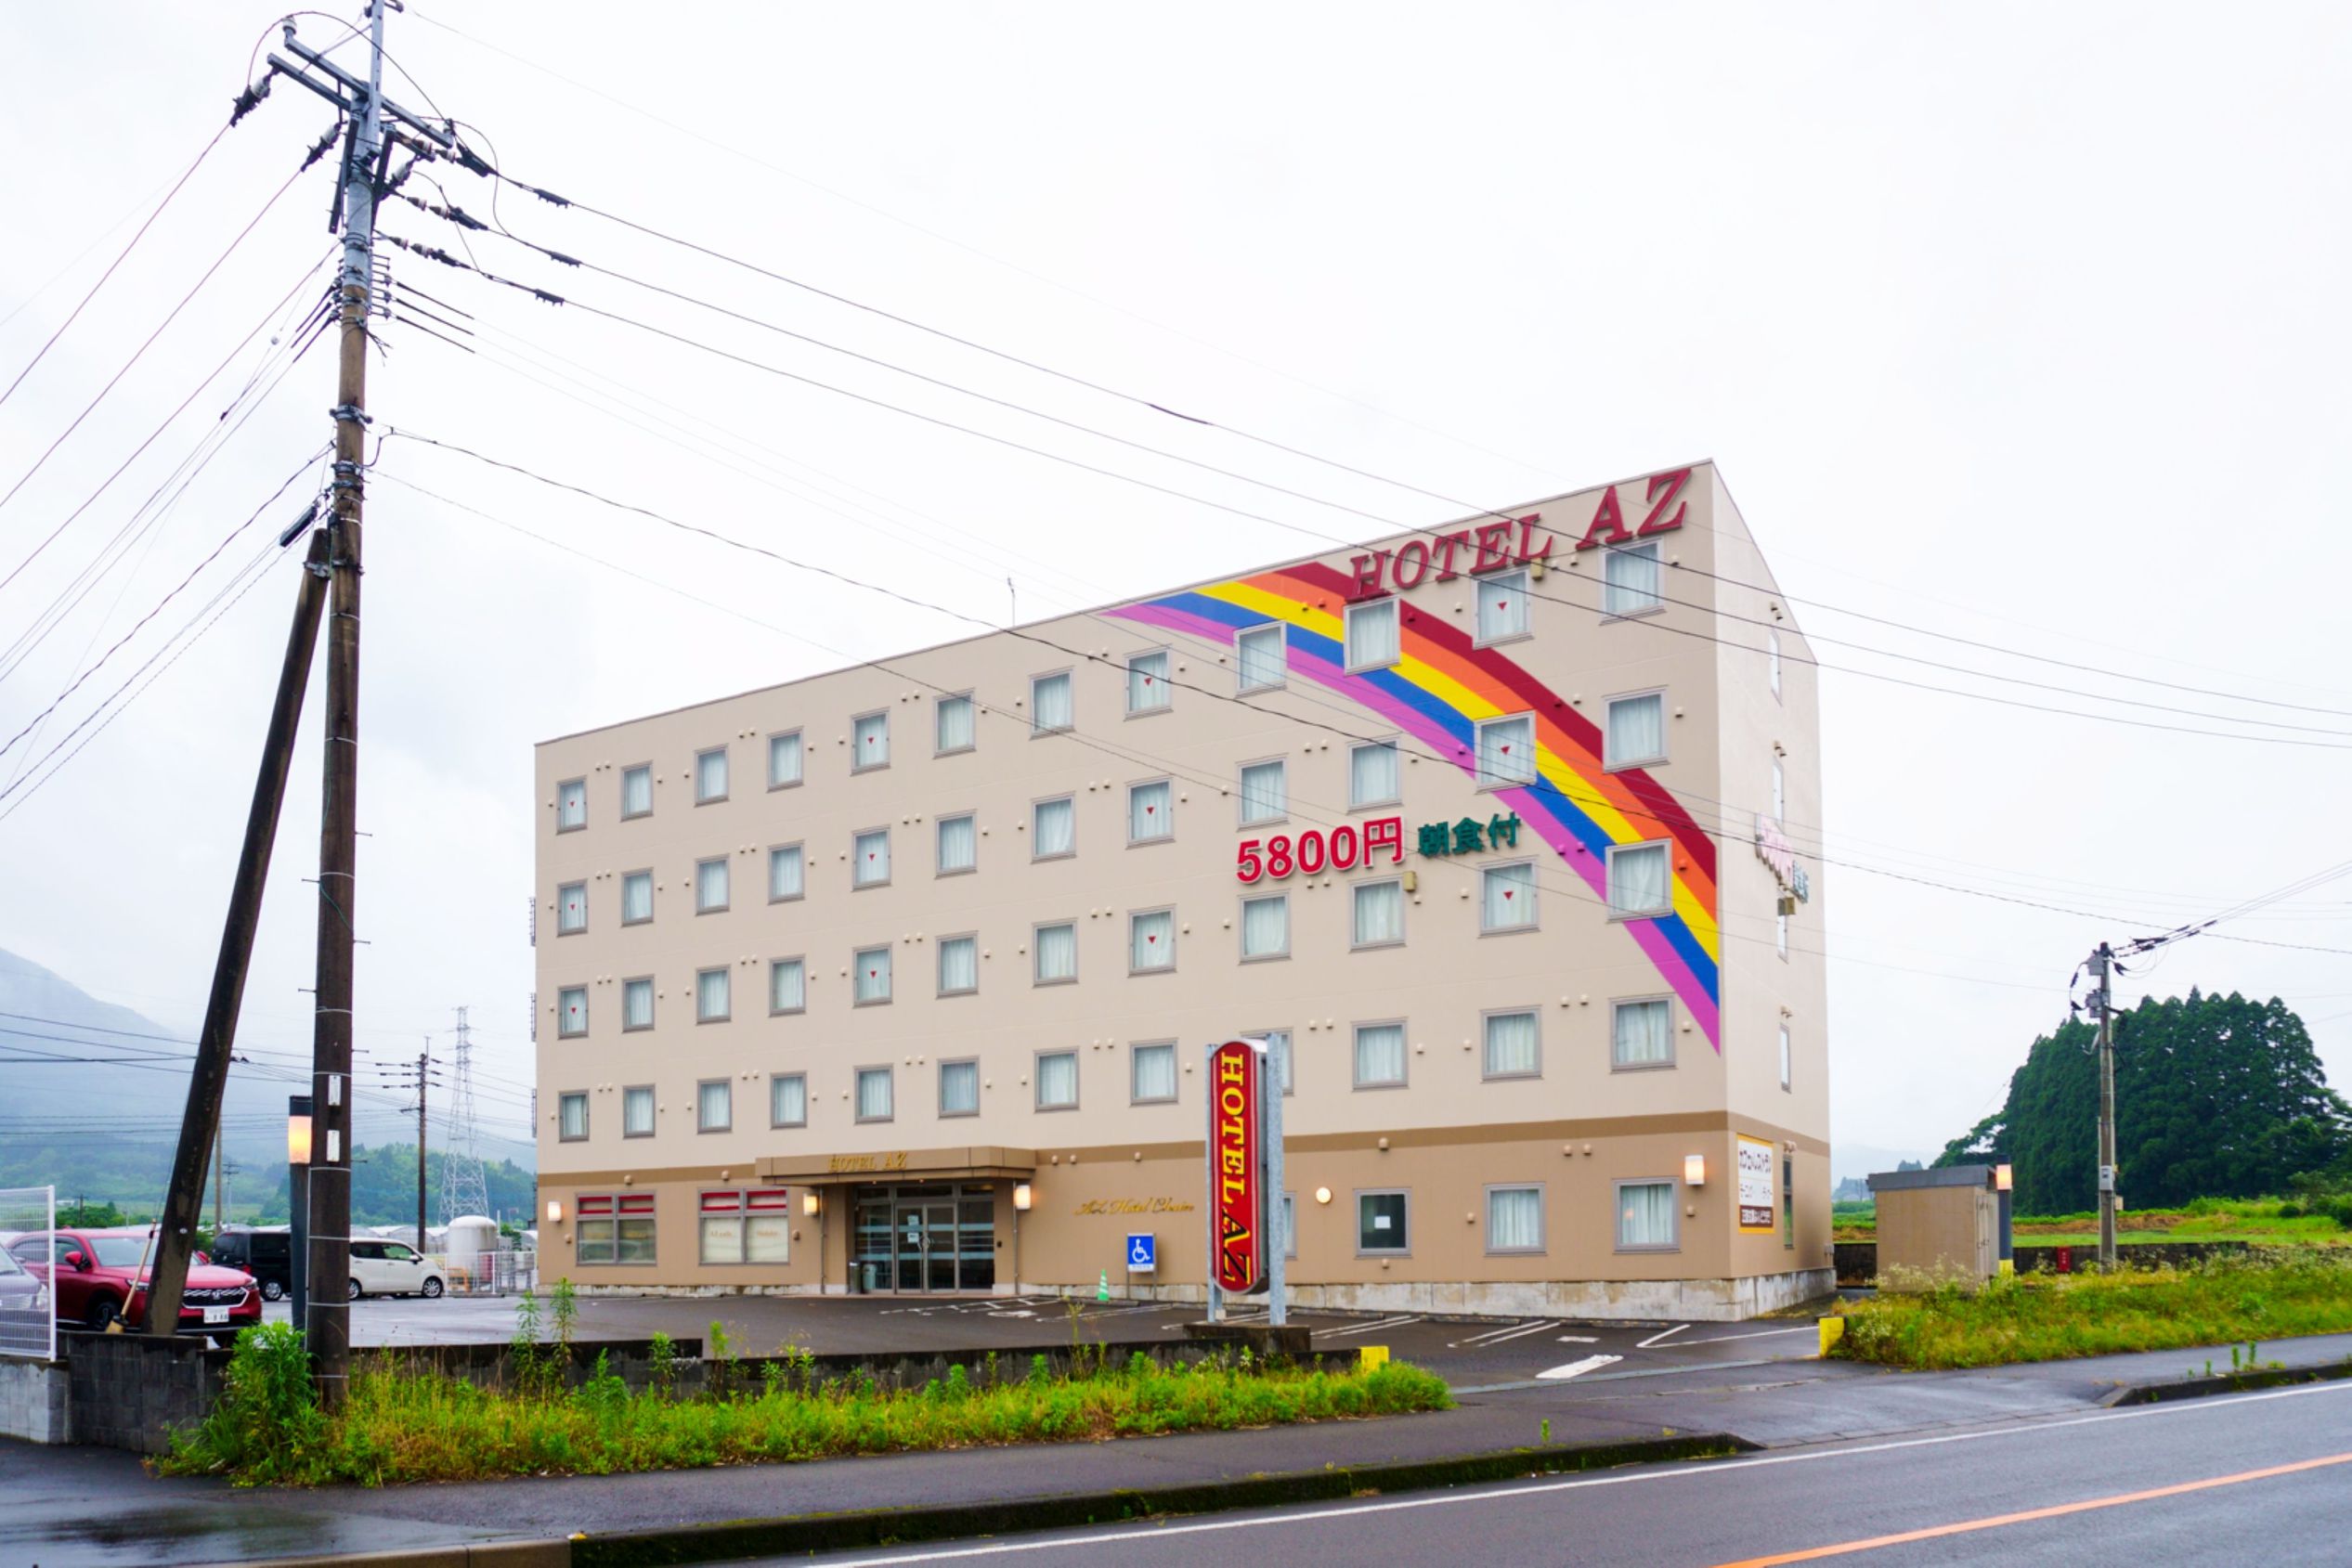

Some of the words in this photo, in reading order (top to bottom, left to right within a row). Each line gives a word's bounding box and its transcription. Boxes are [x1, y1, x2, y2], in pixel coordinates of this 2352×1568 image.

[1344, 512, 1553, 602] HOTEL
[1576, 467, 1692, 551] AZ
[1236, 815, 1404, 883] 5800円
[1418, 811, 1521, 858] 朝食付
[829, 1154, 876, 1172] HOTEL
[885, 1150, 907, 1170] AZ
[1221, 1052, 1245, 1204] HOTEL
[1222, 1206, 1251, 1286] AZ
